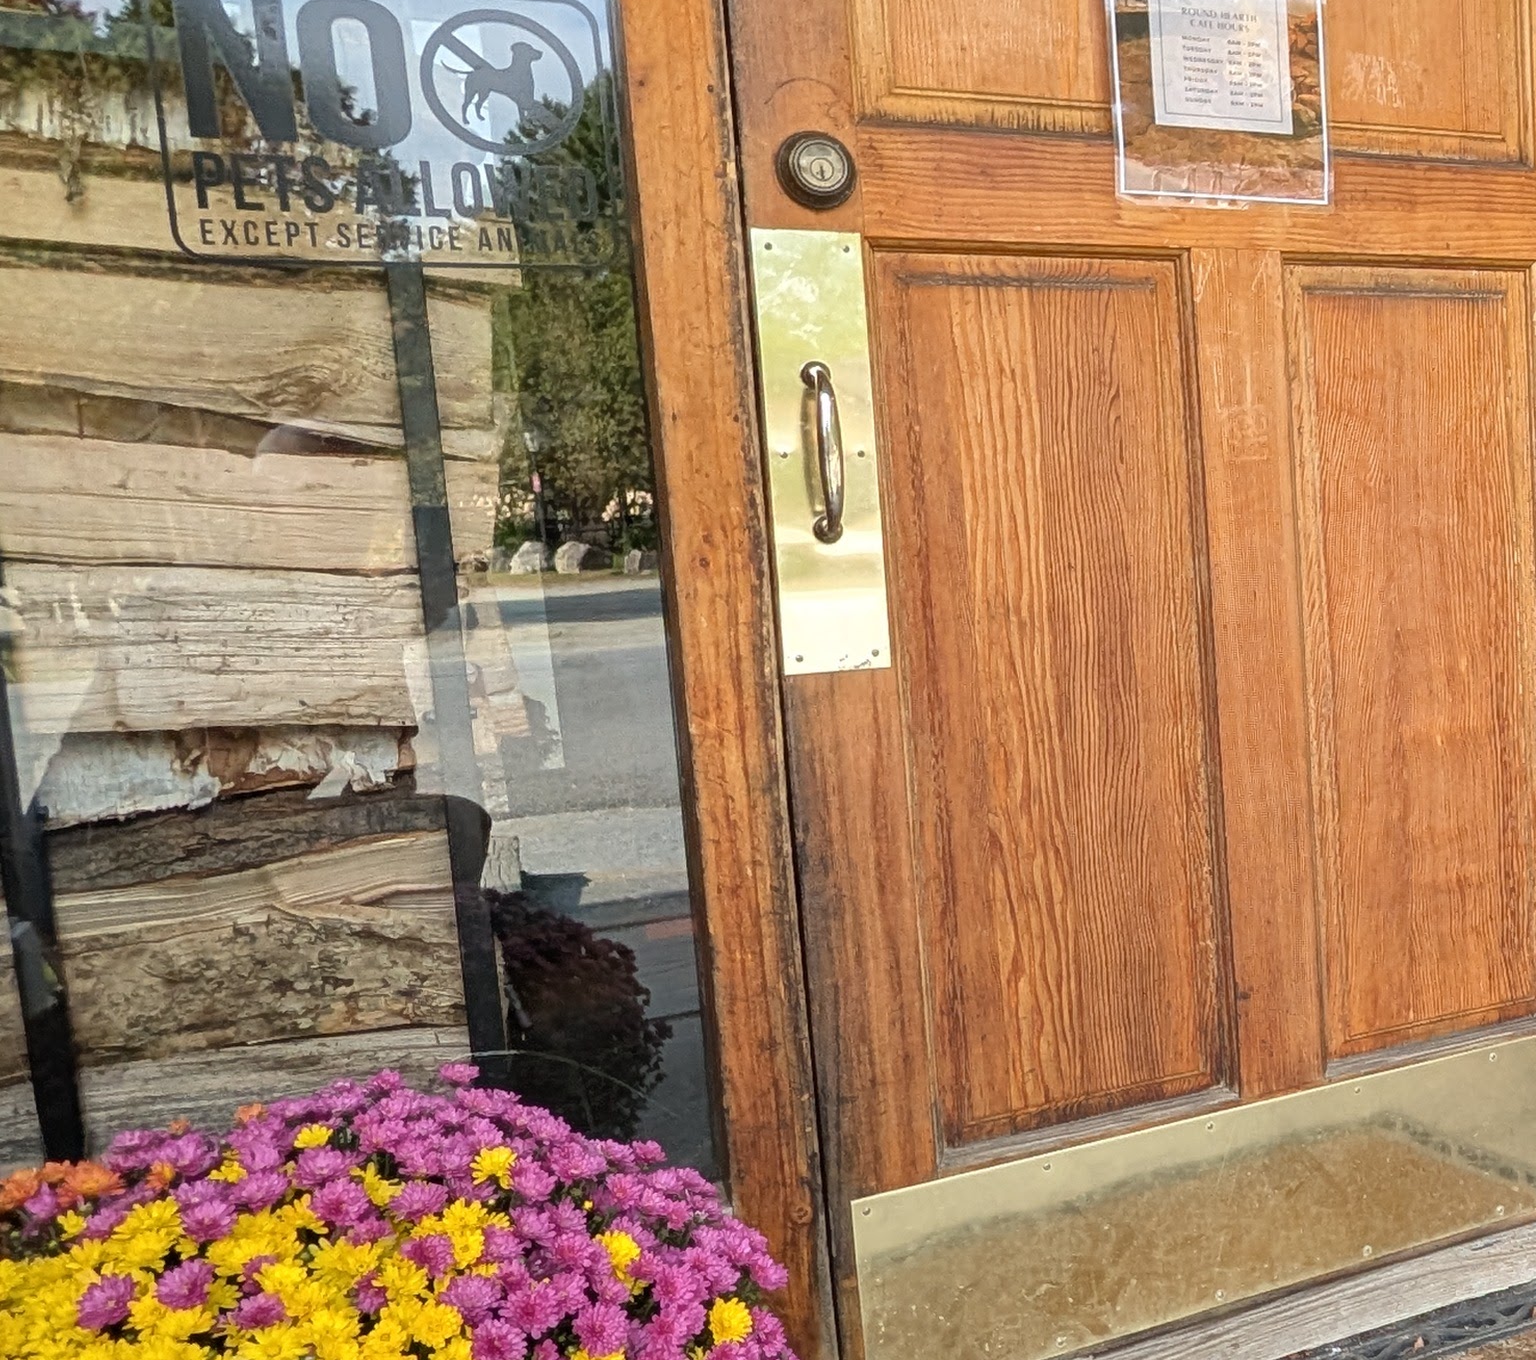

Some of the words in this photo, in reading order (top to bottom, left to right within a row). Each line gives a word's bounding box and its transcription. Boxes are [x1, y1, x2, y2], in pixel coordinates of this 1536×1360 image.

[1181, 7, 1217, 18] ROUND
[1217, 22, 1250, 32] HOURS
[193, 151, 335, 213] PETS
[356, 160, 599, 222] ALLOWED
[200, 219, 319, 248] EXCEPT
